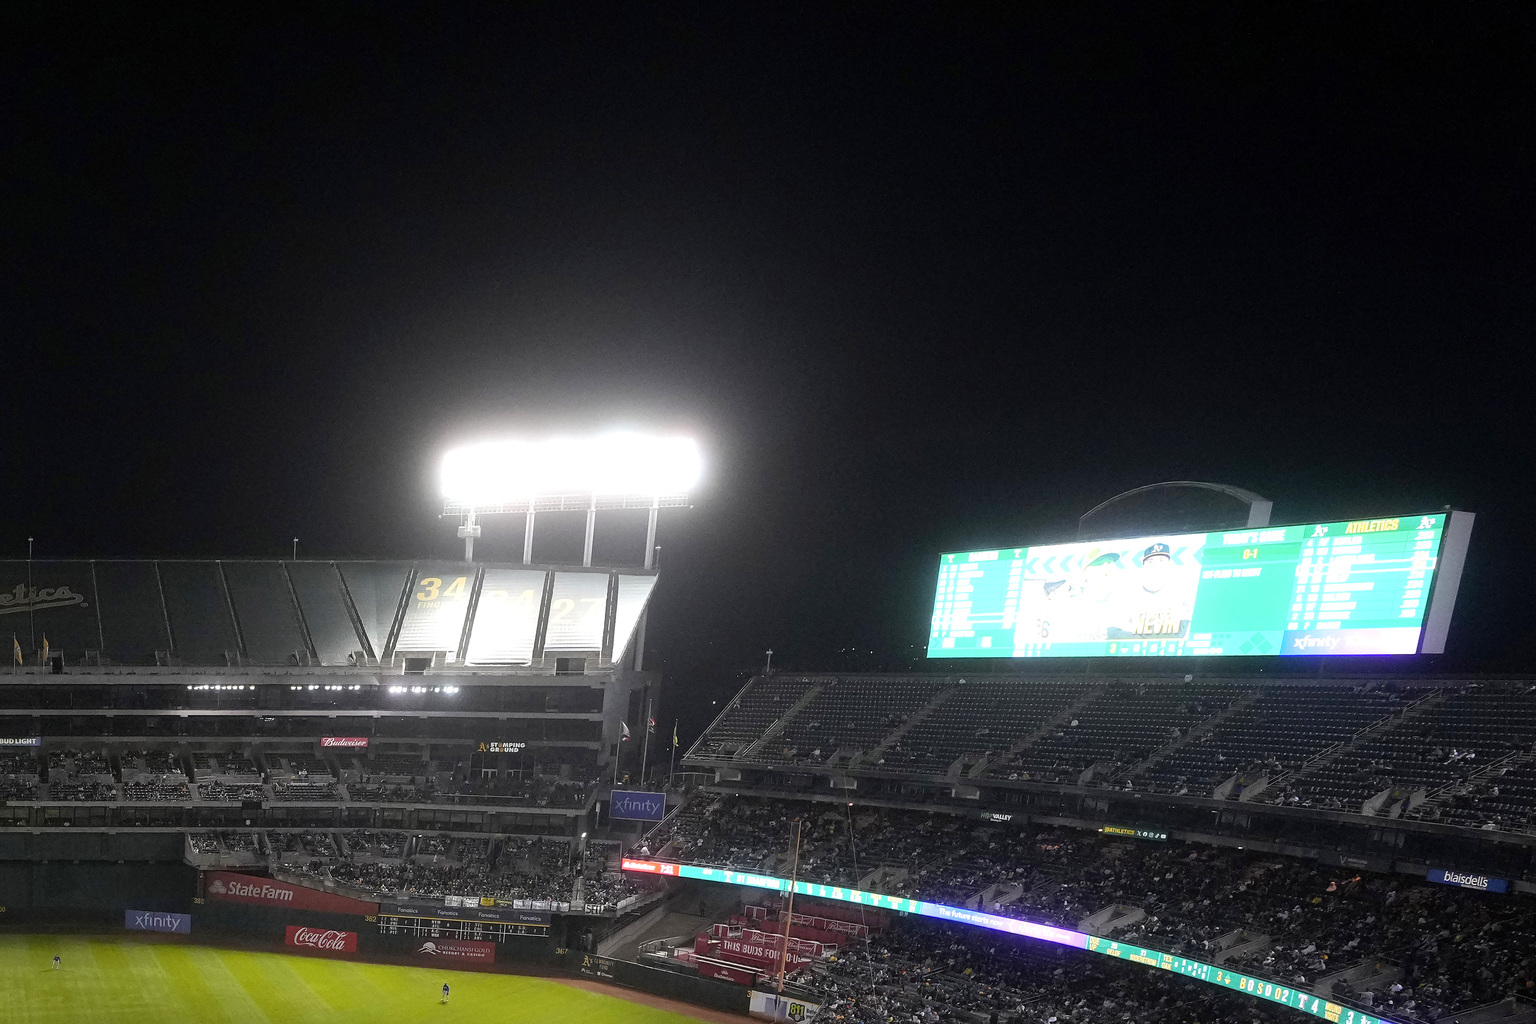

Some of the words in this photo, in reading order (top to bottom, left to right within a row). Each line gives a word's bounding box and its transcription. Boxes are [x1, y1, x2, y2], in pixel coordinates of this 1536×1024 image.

[1345, 518, 1400, 534] ATHLETICS
[1243, 548, 1258, 560] 0-1
[416, 576, 467, 601] 34
[1132, 612, 1181, 635] NEVIN
[1293, 634, 1340, 649] xfinity
[322, 738, 366, 747] Budweiser
[615, 797, 660, 815] xfinity
[992, 813, 1012, 821] VALLEY
[437, 909, 459, 917] Fanatics
[520, 914, 542, 922] Fanatics
[939, 907, 951, 917] The
[951, 909, 970, 921] future
[971, 914, 989, 925] starts
[989, 919, 1004, 927] now
[135, 913, 181, 931] xfinity
[724, 940, 740, 952] THIS
[1089, 936, 1100, 945] DUE
[1163, 954, 1173, 963] TEX
[1161, 962, 1172, 970] OAK
[1216, 971, 1222, 982] 3
[790, 1003, 805, 1017] 811
[1311, 1000, 1319, 1013] 4
